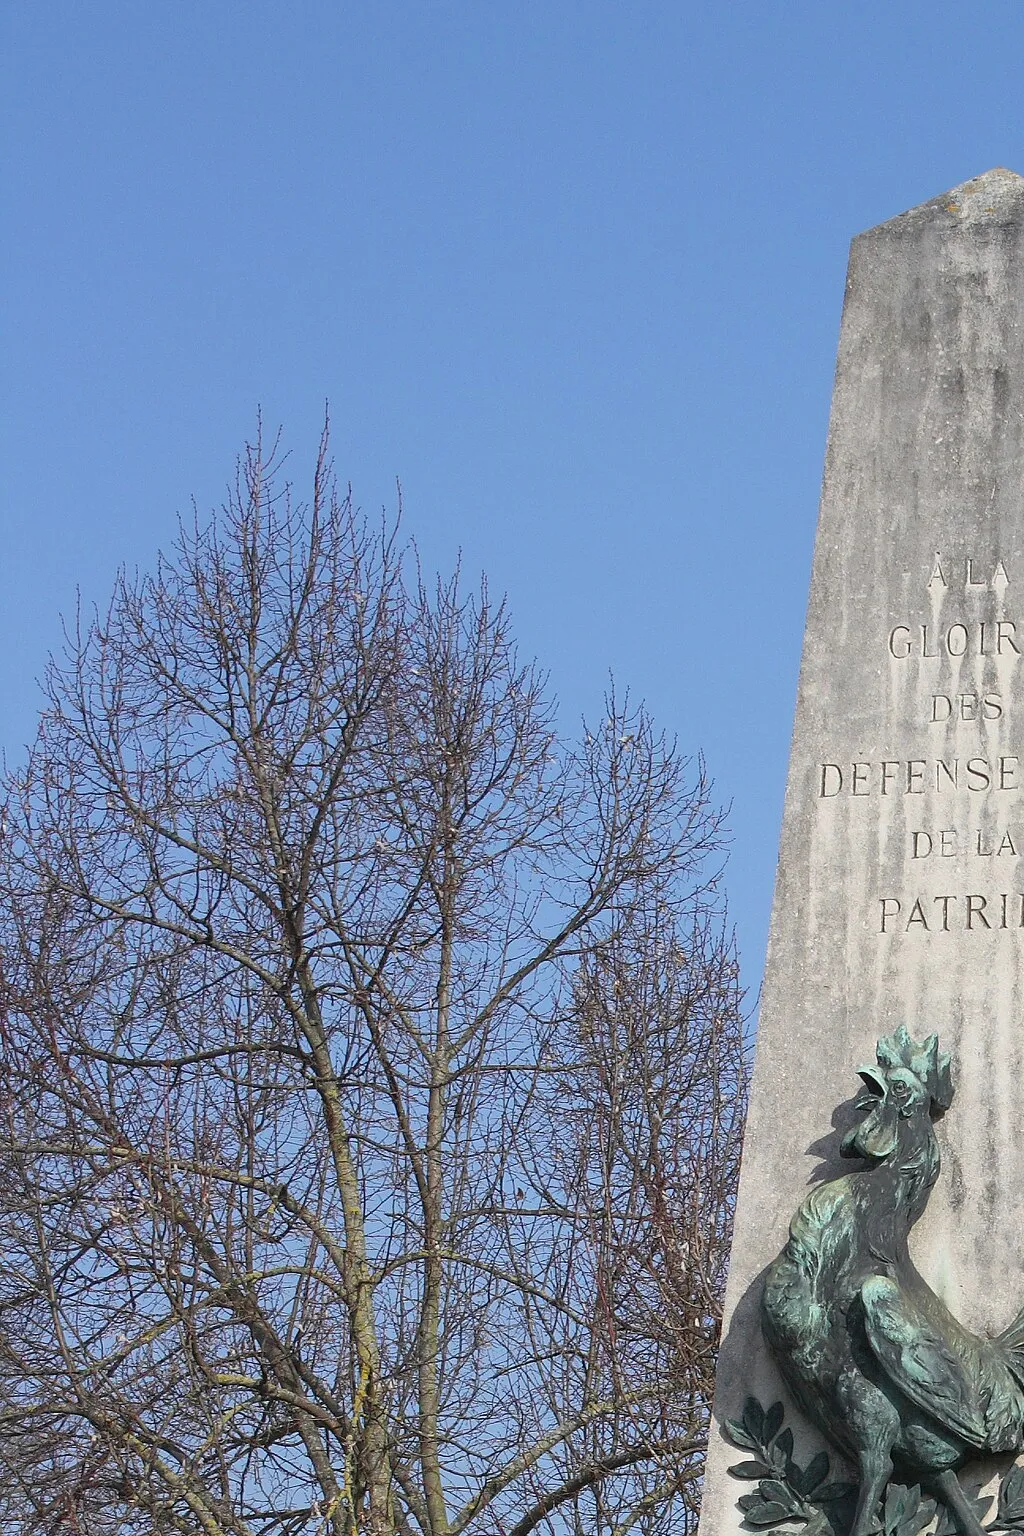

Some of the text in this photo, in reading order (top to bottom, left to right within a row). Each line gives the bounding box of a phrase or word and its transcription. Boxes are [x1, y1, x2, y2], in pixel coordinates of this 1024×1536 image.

[966, 558, 1011, 587] LA
[929, 692, 1004, 723] DES
[910, 829, 1019, 860] DE LA
